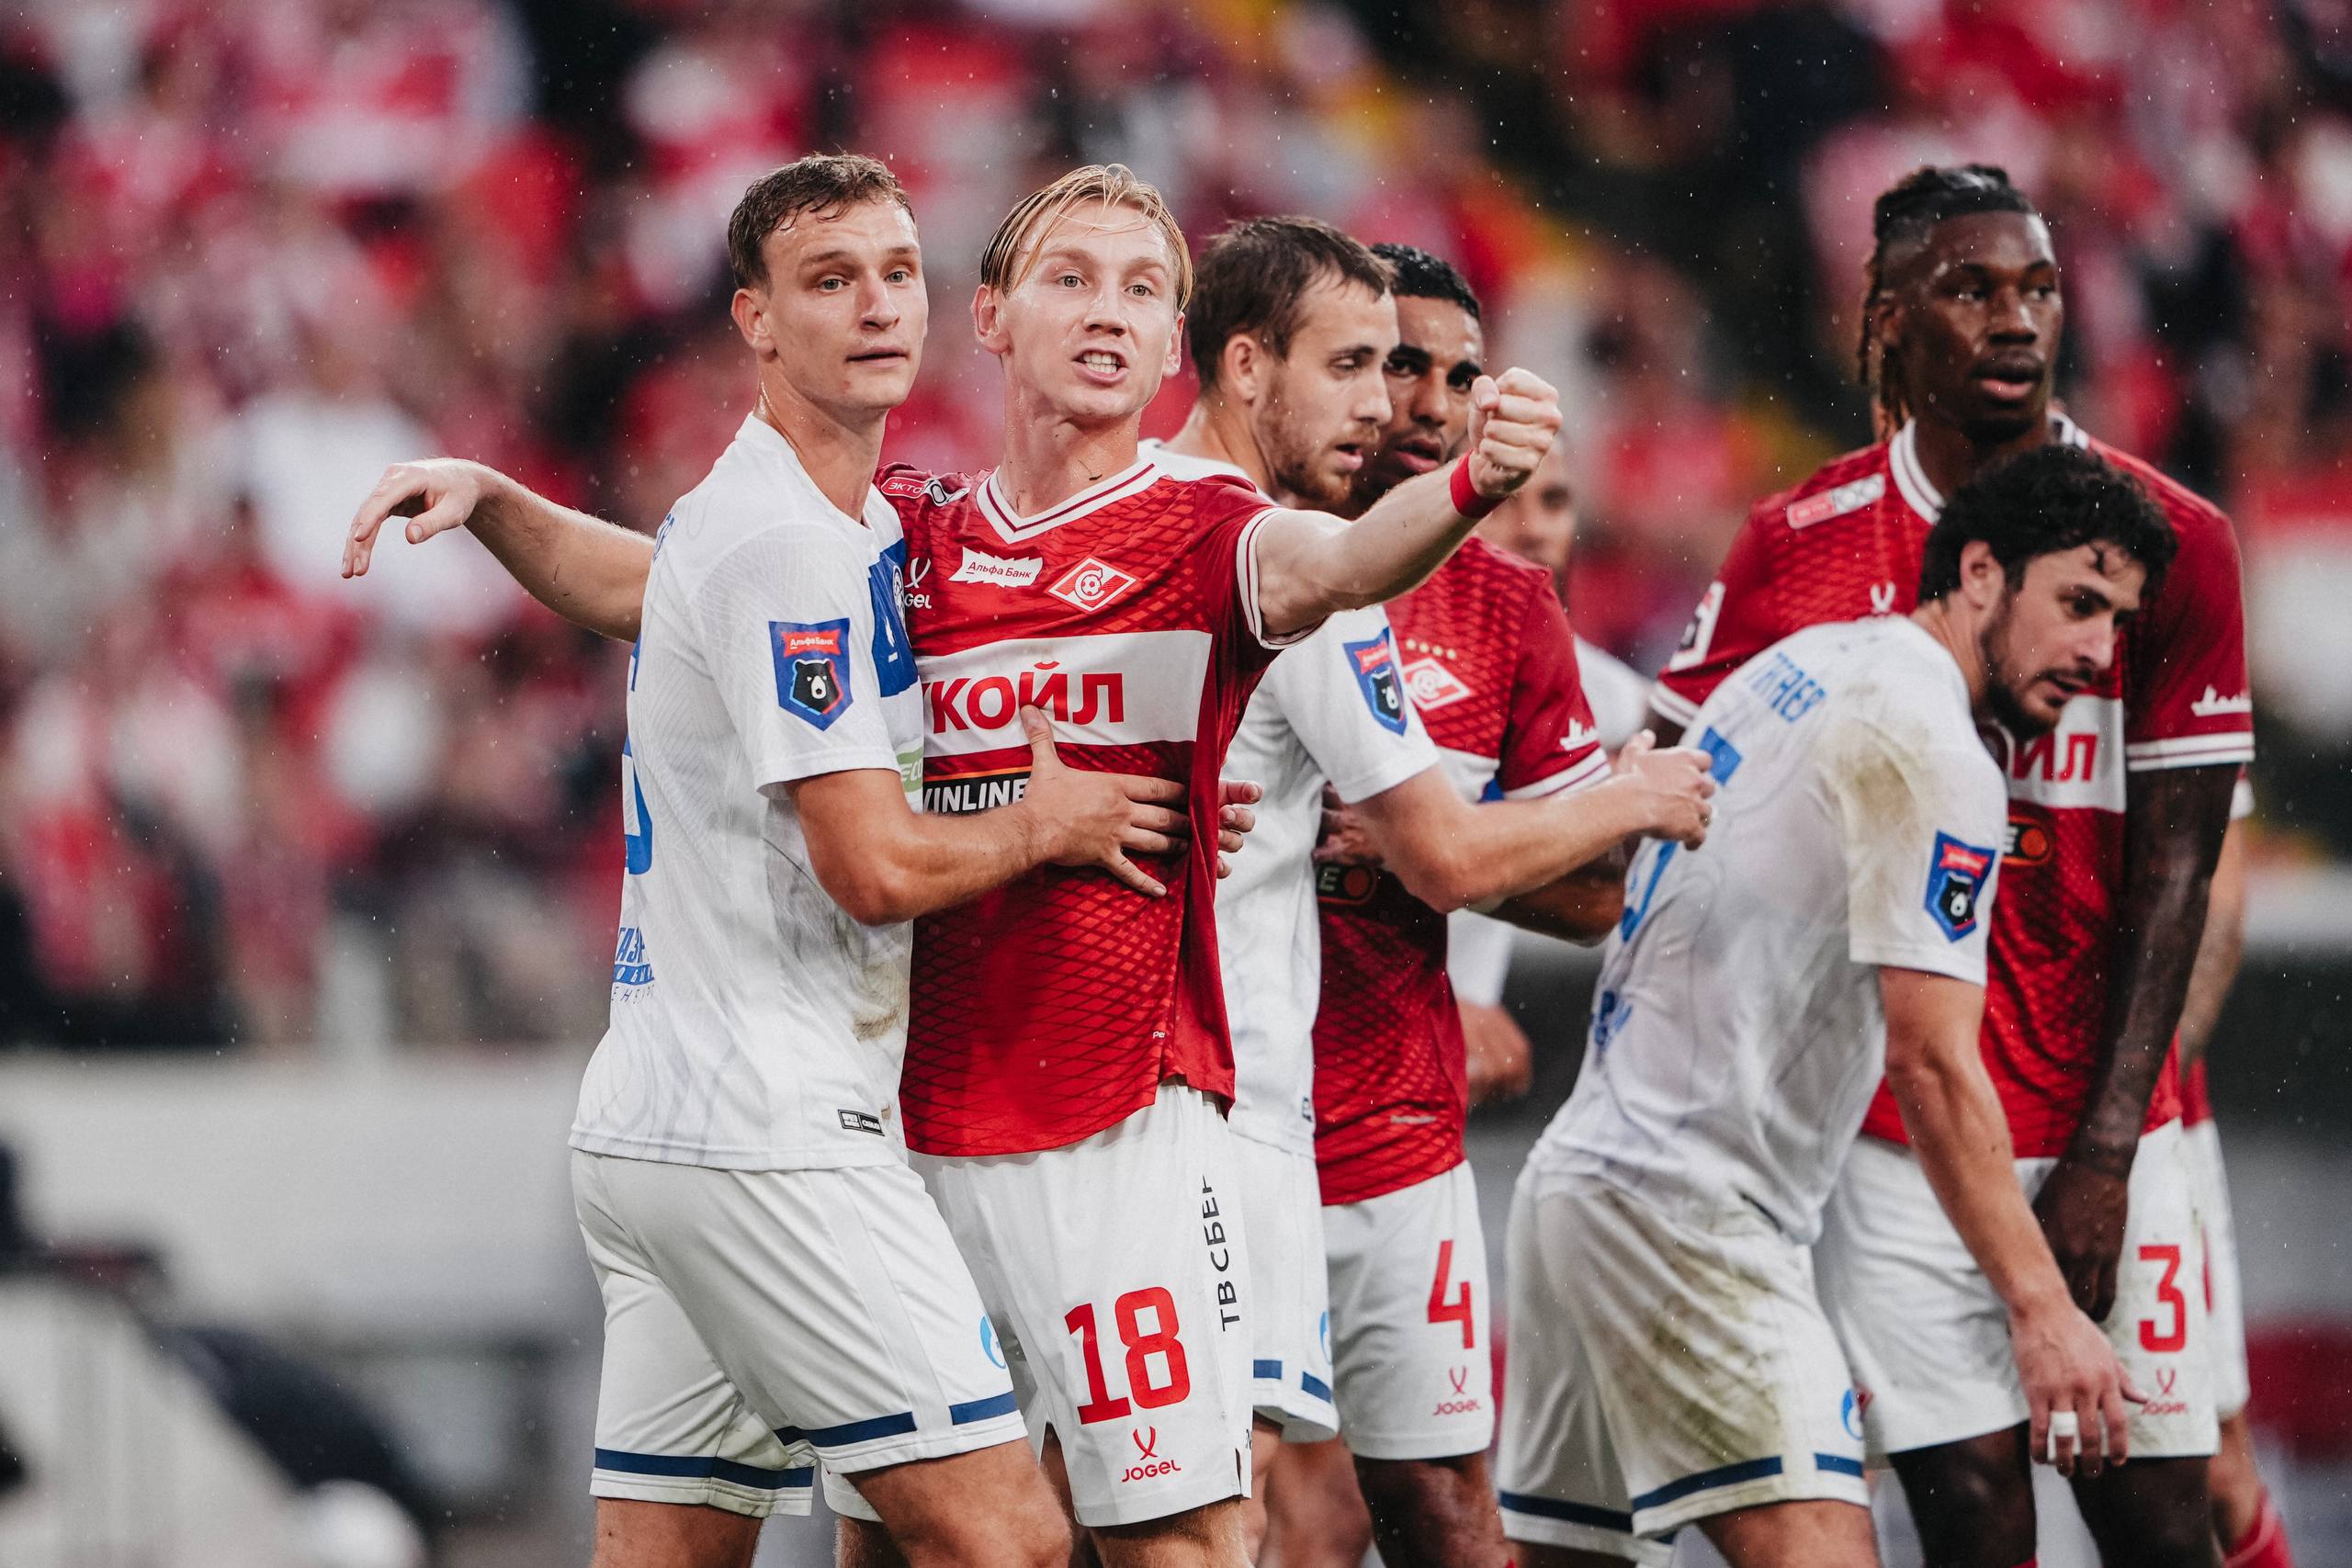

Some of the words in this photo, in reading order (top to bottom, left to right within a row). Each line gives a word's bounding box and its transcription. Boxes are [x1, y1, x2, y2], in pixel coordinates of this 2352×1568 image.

[966, 561, 1003, 576] Альфа
[1005, 567, 1032, 579] Банк
[922, 660, 1125, 735] КОЙЛ
[923, 777, 1030, 814] INLINE
[1217, 1280, 1240, 1332] ТВ
[1427, 1239, 1475, 1349] 4
[2138, 1246, 2186, 1353] 3
[1064, 1286, 1191, 1425] 18
